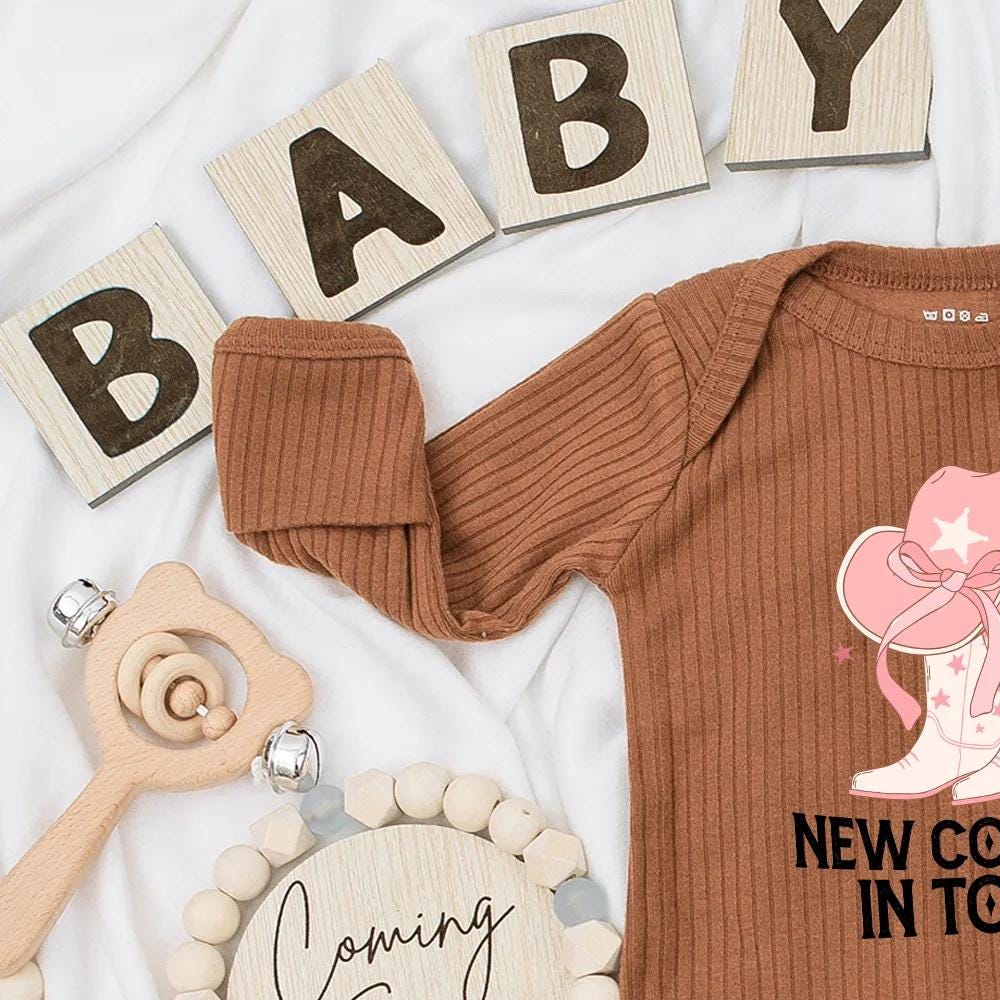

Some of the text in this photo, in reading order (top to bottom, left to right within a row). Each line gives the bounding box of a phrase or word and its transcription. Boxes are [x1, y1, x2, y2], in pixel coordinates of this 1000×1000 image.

[28, 0, 903, 458] BABY
[792, 812, 915, 871] NEW
[857, 879, 918, 940] IN
